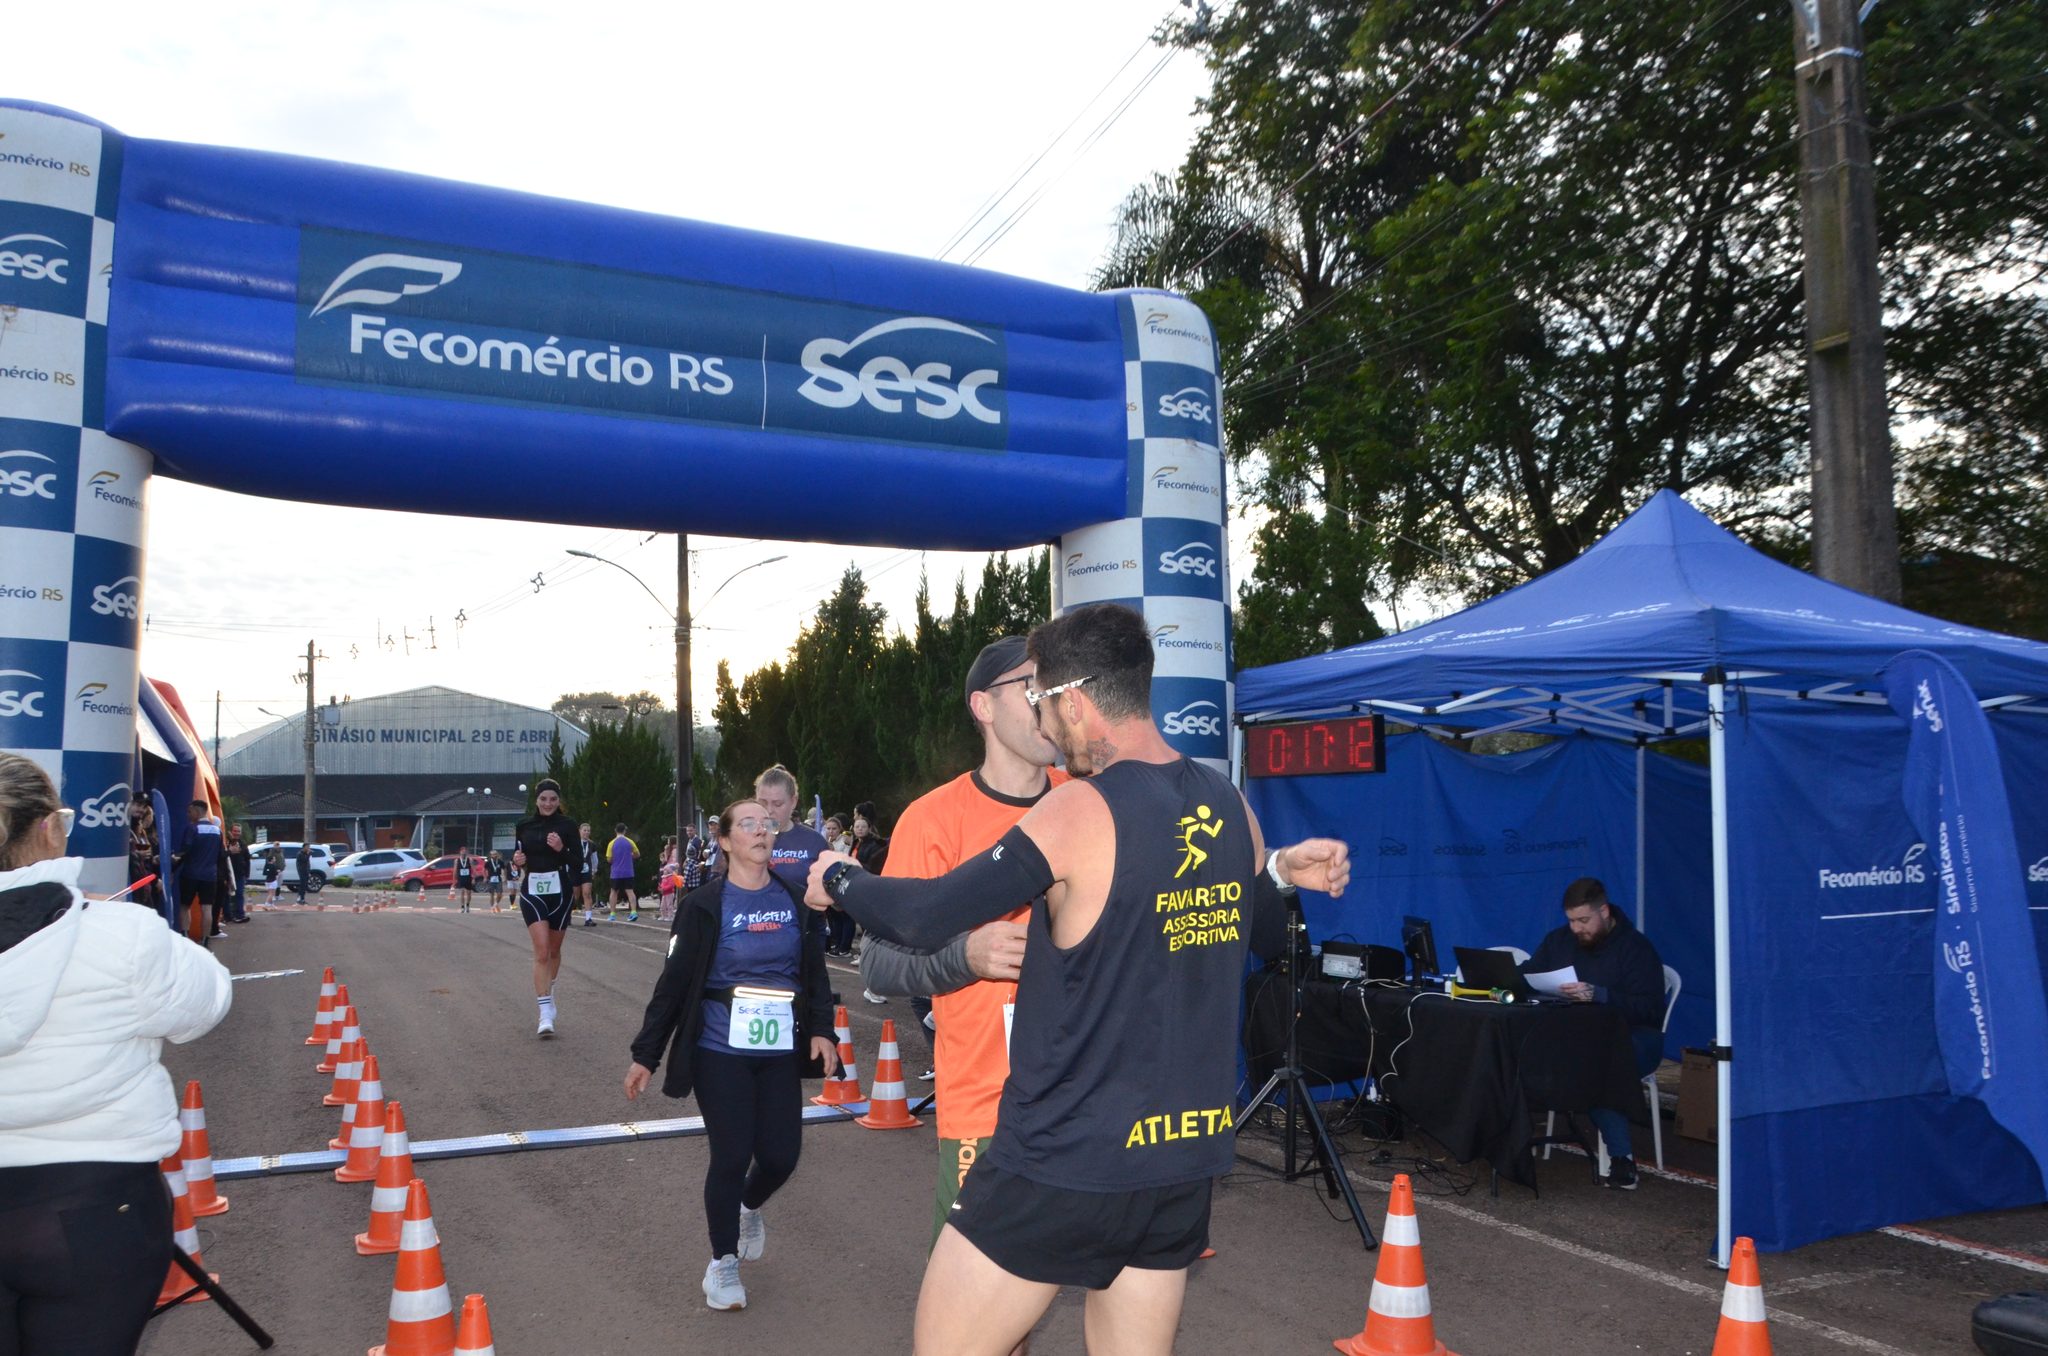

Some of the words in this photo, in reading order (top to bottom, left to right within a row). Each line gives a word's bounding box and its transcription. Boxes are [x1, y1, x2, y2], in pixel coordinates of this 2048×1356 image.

[69, 161, 90, 177] RS
[350, 313, 653, 386] Fecomércio
[669, 353, 734, 395] RS
[54, 371, 76, 387] RS
[797, 328, 1001, 424] Sesc
[1158, 391, 1213, 424] Sesc
[1157, 479, 1210, 495] Fecomércio
[1068, 559, 1119, 577] Fecomércio
[1122, 559, 1137, 569] RS
[1158, 548, 1216, 578] Sesc
[42, 588, 63, 602] RS
[1158, 637, 1213, 650] Fecomércio
[313, 726, 375, 743] GINÁSIO
[381, 729, 466, 743] MUNICIPAL
[471, 729, 490, 743] 29
[495, 730, 514, 743] DE
[520, 730, 557, 743] ABRI
[1163, 710, 1221, 735] Sesc
[536, 881, 552, 893] 67
[1819, 866, 1903, 888] Fecomércio
[1905, 864, 1925, 884] RS
[1170, 926, 1240, 951] ESORTIVA
[1955, 940, 1973, 968] RS
[748, 1018, 779, 1046] 90
[1126, 1104, 1233, 1148] ATLETA
